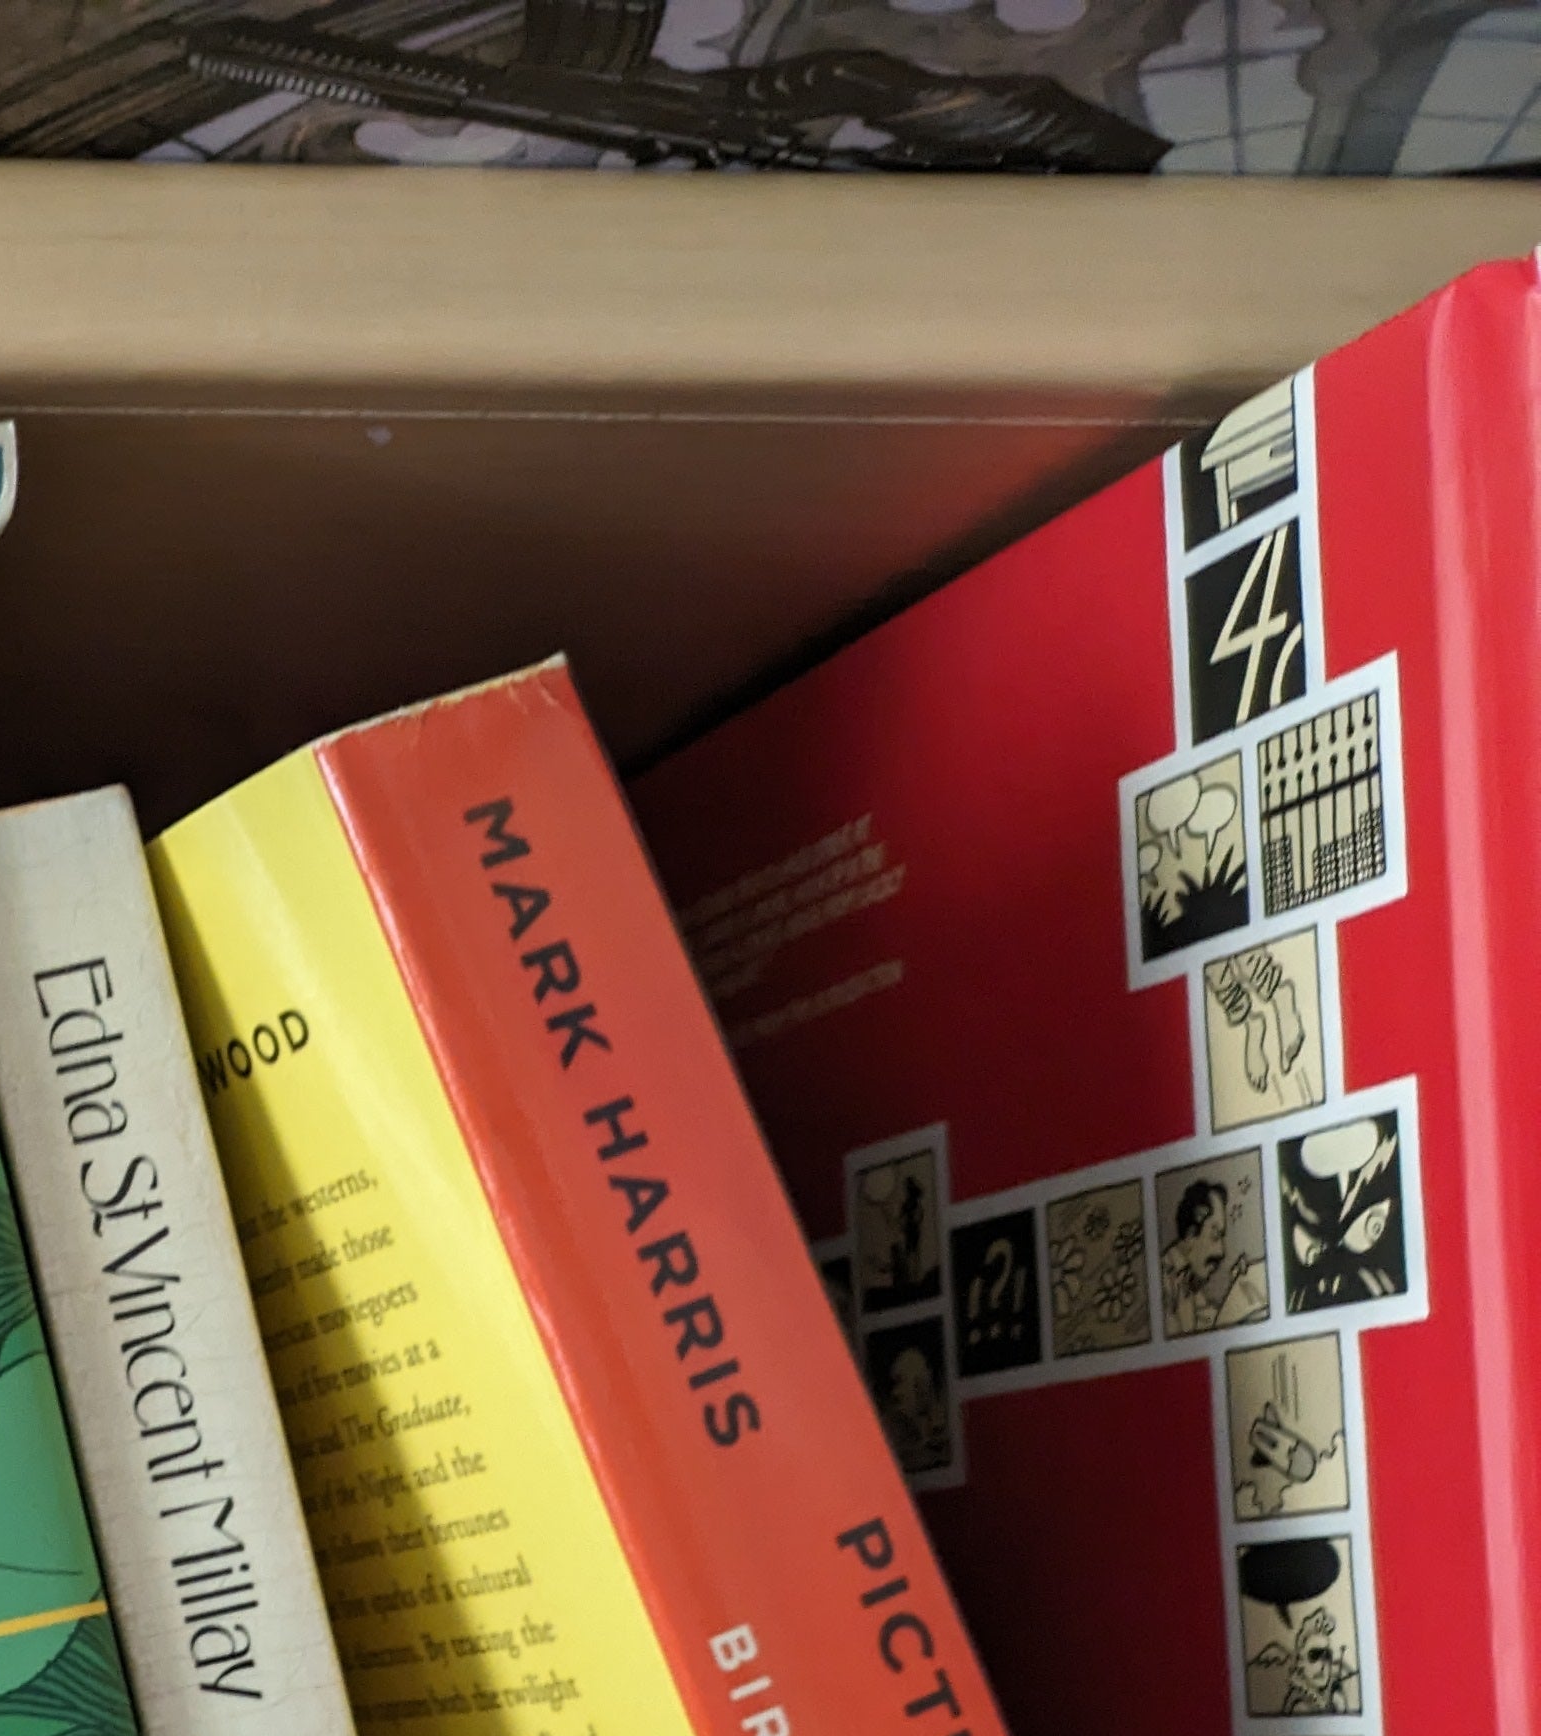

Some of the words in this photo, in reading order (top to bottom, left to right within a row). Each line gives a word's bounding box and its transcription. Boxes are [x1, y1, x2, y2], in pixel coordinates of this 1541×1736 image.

[33, 957, 129, 1146] Edna
[462, 796, 614, 1071] MARK
[582, 1096, 762, 1449] HARRIS
[101, 1226, 227, 1485] Vincent
[159, 1495, 264, 1701] Millay
